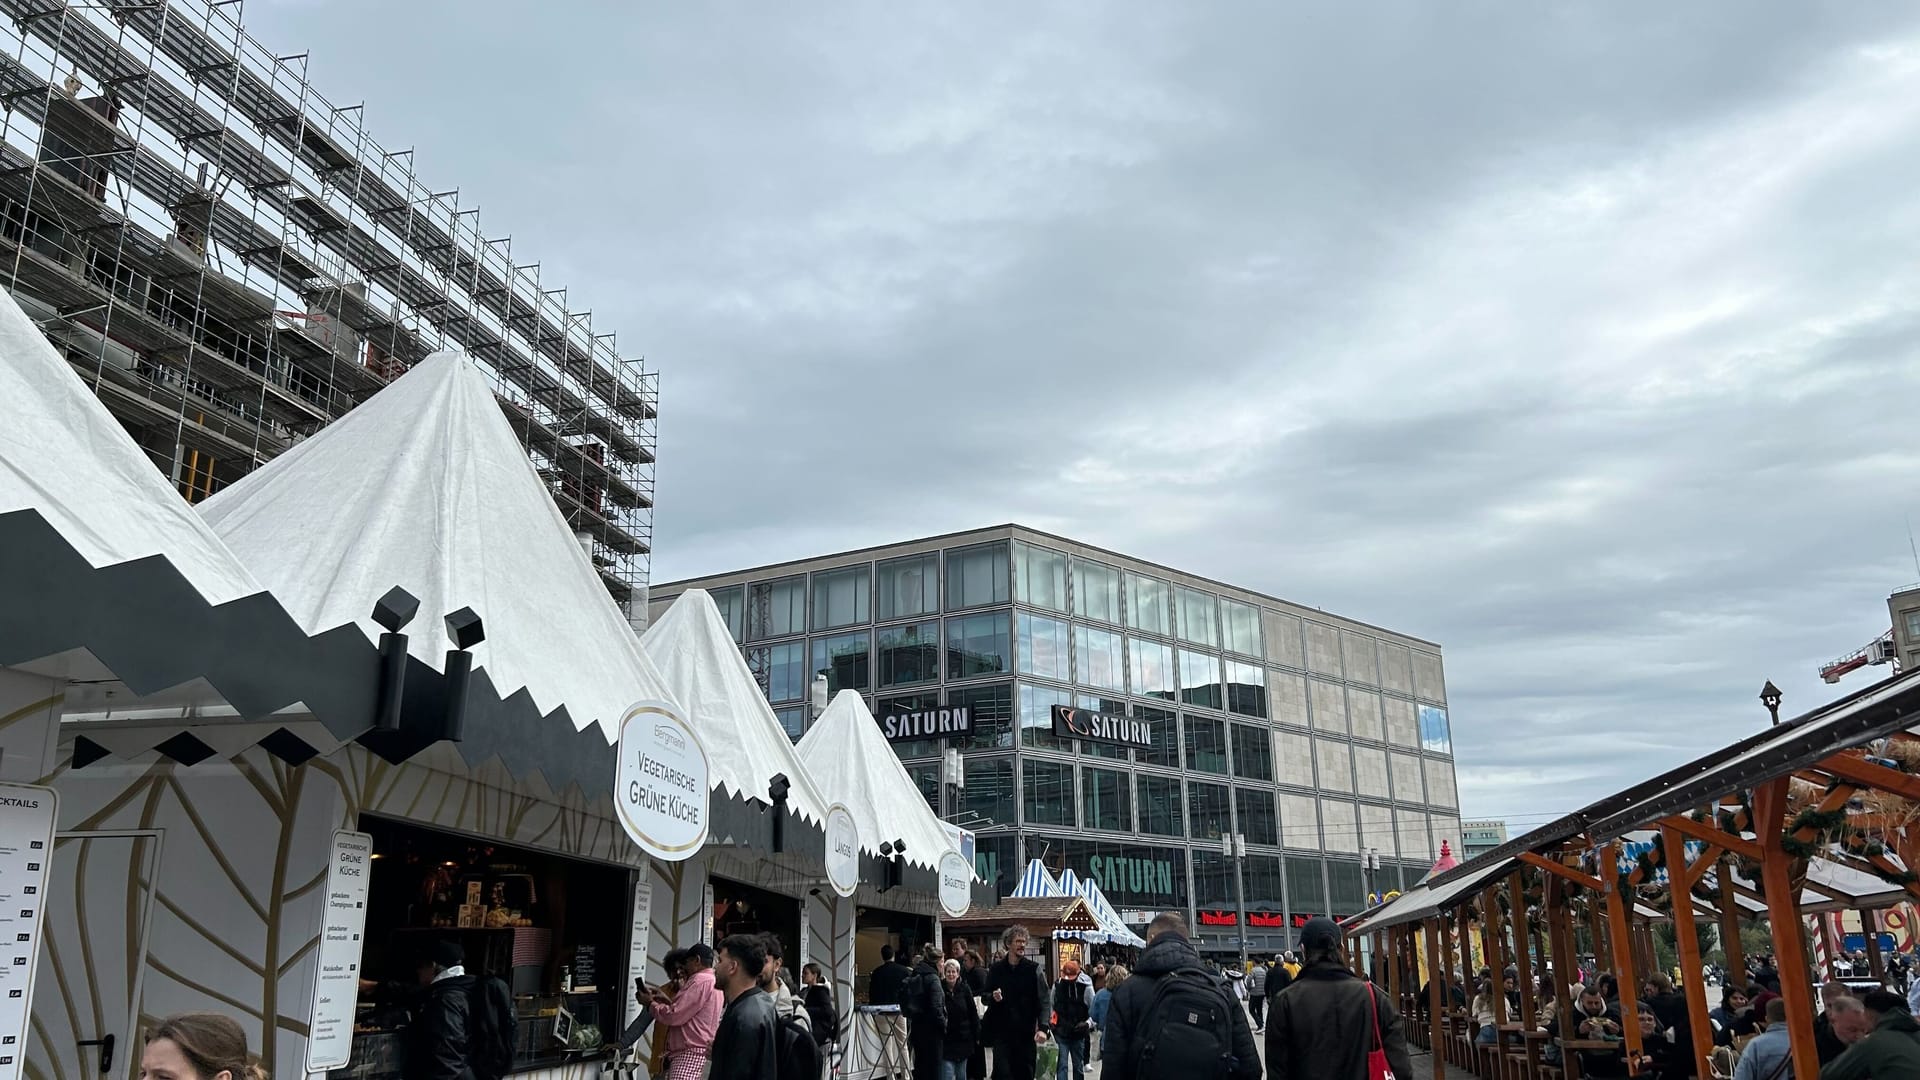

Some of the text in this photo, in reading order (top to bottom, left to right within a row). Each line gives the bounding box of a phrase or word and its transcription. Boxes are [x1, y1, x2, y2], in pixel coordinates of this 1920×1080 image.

[654, 724, 686, 751] Bergmann
[885, 707, 968, 739] SATURN
[1091, 714, 1151, 745] SATURN
[638, 750, 695, 793] VEGETARISCHE
[629, 779, 699, 825] GRÜNE KÜCHE
[339, 865, 361, 877] KÜCHE
[340, 852, 362, 864] GRÜNE
[1089, 854, 1173, 895] SATURN
